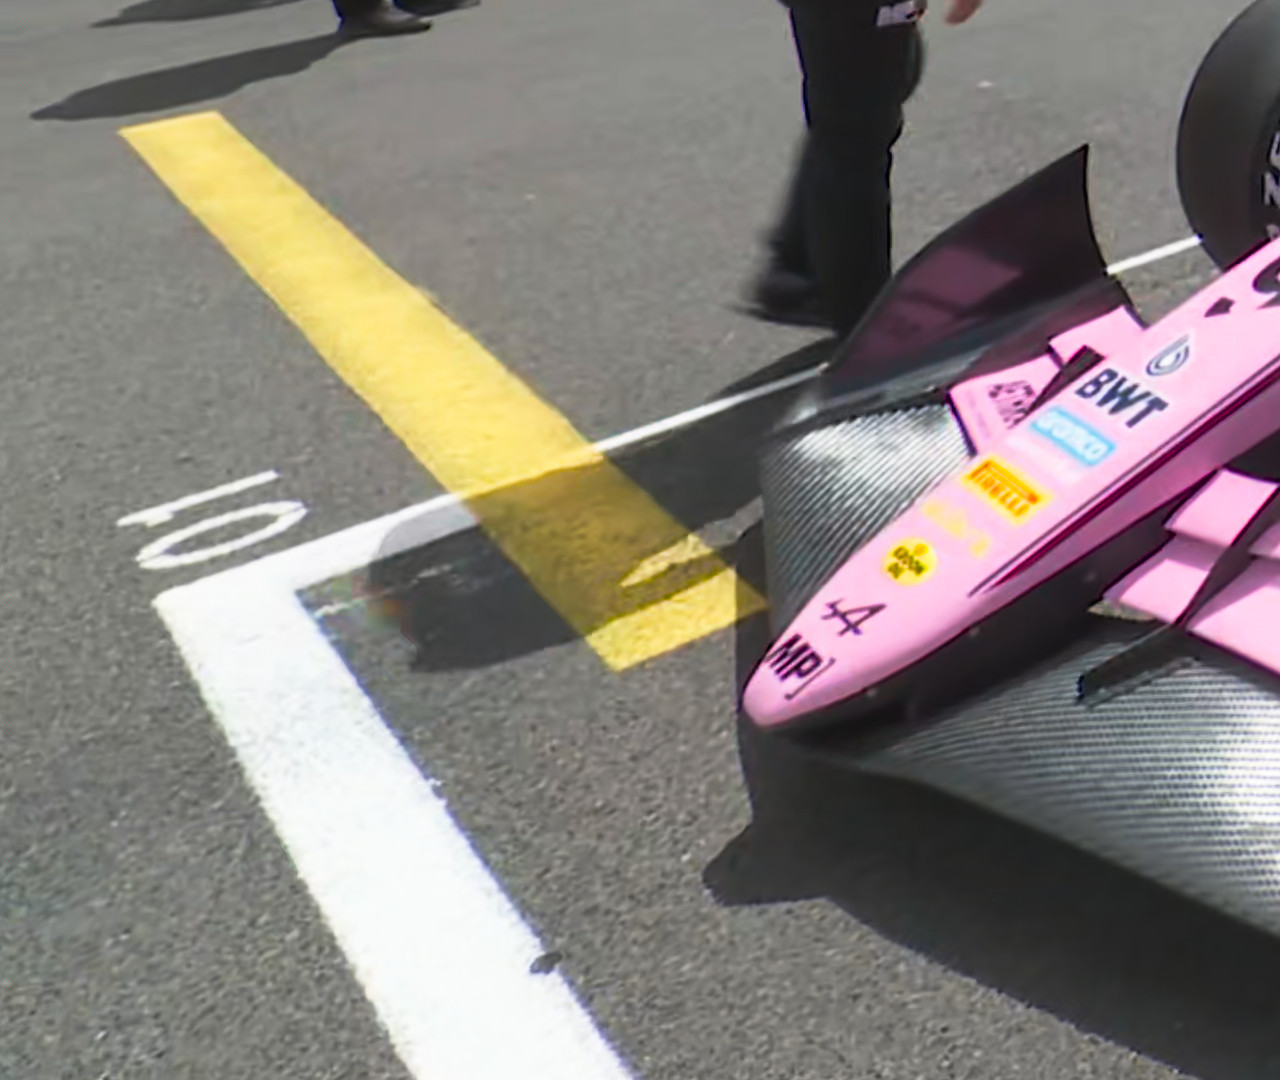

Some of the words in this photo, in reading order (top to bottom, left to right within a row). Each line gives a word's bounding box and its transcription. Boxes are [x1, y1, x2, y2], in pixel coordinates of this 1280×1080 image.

[1074, 368, 1169, 428] BWT
[968, 459, 1041, 518] PIRELLI
[116, 468, 309, 570] 10
